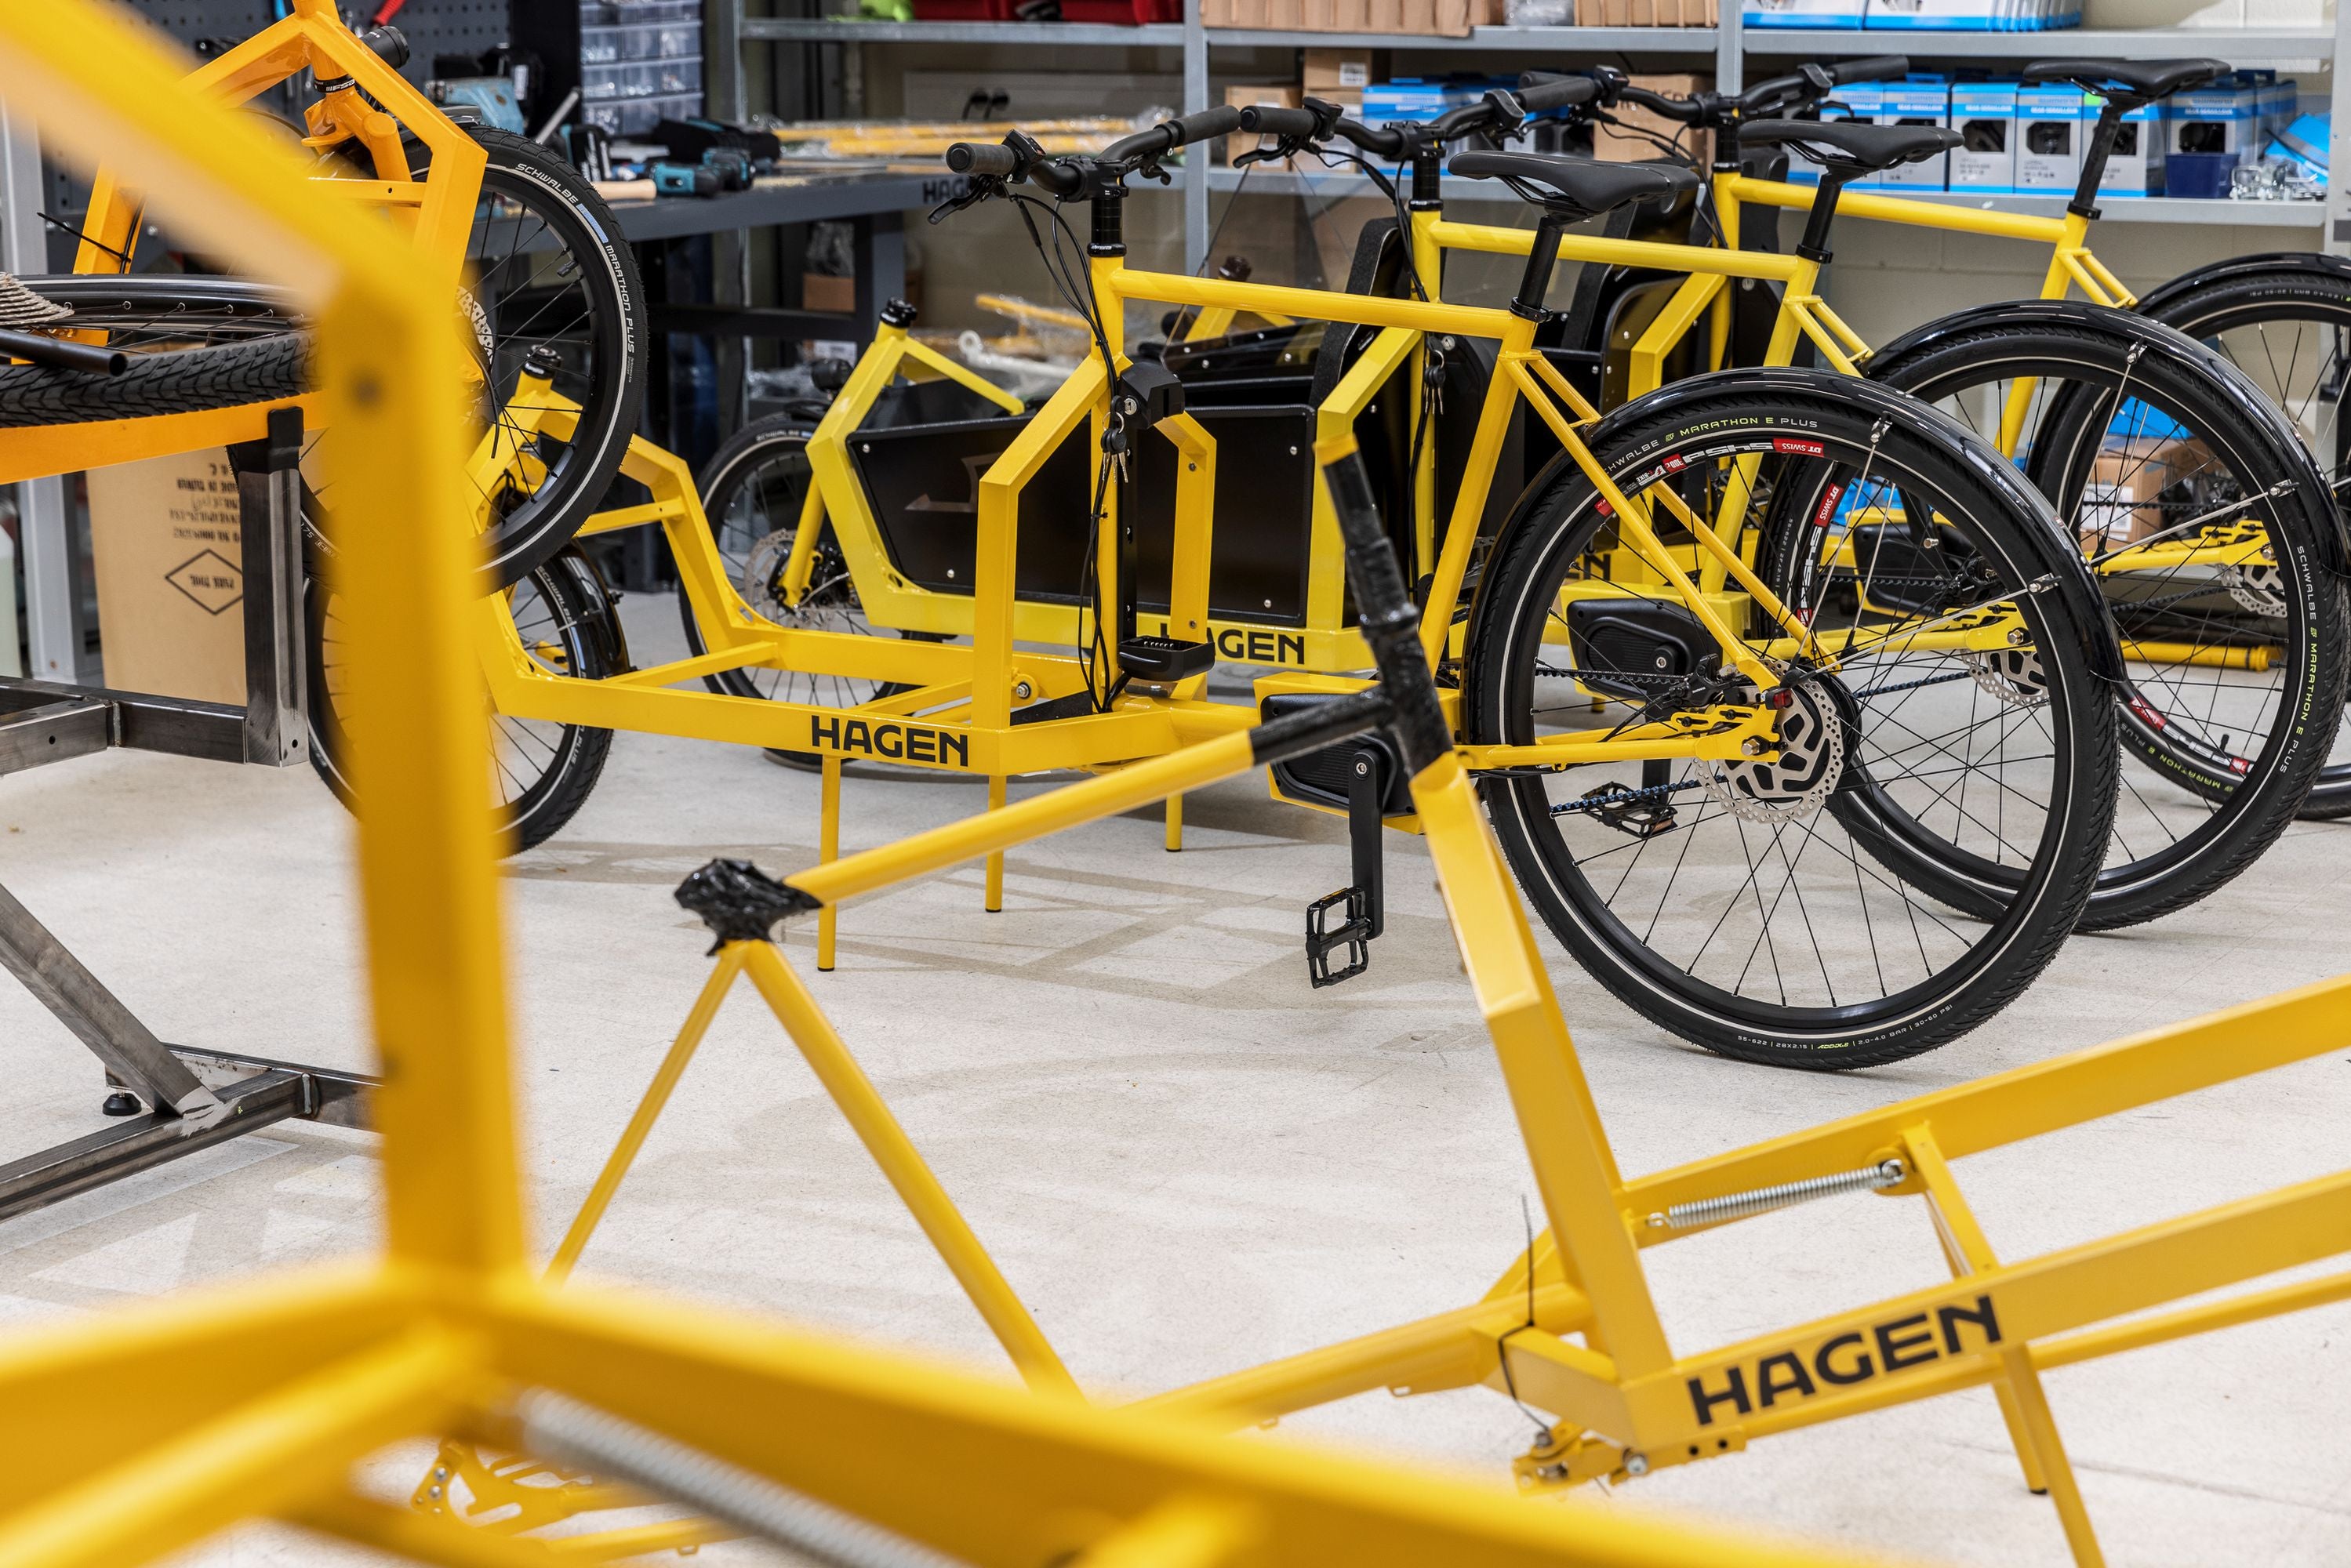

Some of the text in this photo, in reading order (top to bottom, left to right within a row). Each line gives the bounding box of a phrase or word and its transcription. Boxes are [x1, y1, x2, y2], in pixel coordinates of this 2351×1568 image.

[515, 162, 579, 205] SCHWALBE
[922, 178, 968, 205] HAG
[605, 245, 631, 311] MARATHON
[626, 318, 635, 354] PLUS
[1604, 439, 1660, 474] HWALBE
[1680, 416, 1758, 437] MARATHON
[1780, 417, 1818, 428] PLUS
[1782, 442, 1806, 452] SWISS
[1819, 499, 1833, 521] SWISS
[1831, 485, 1840, 500] DT
[538, 564, 573, 624] SCHWALBE
[1161, 622, 1306, 665] GEN
[2280, 545, 2318, 774] SCHWALBE MARATHON E PLUS
[811, 715, 968, 768] HAGEN
[2120, 721, 2146, 754] PLUS
[2159, 754, 2222, 789] MARATHON
[1738, 1035, 1768, 1047] 55-622
[1858, 1035, 1887, 1046] 2.0-4.0
[1889, 1028, 1908, 1038] BAR
[1914, 1013, 1938, 1028] 30-60
[1939, 1004, 1953, 1015] PSI
[1688, 1294, 2002, 1425] HAGEN
